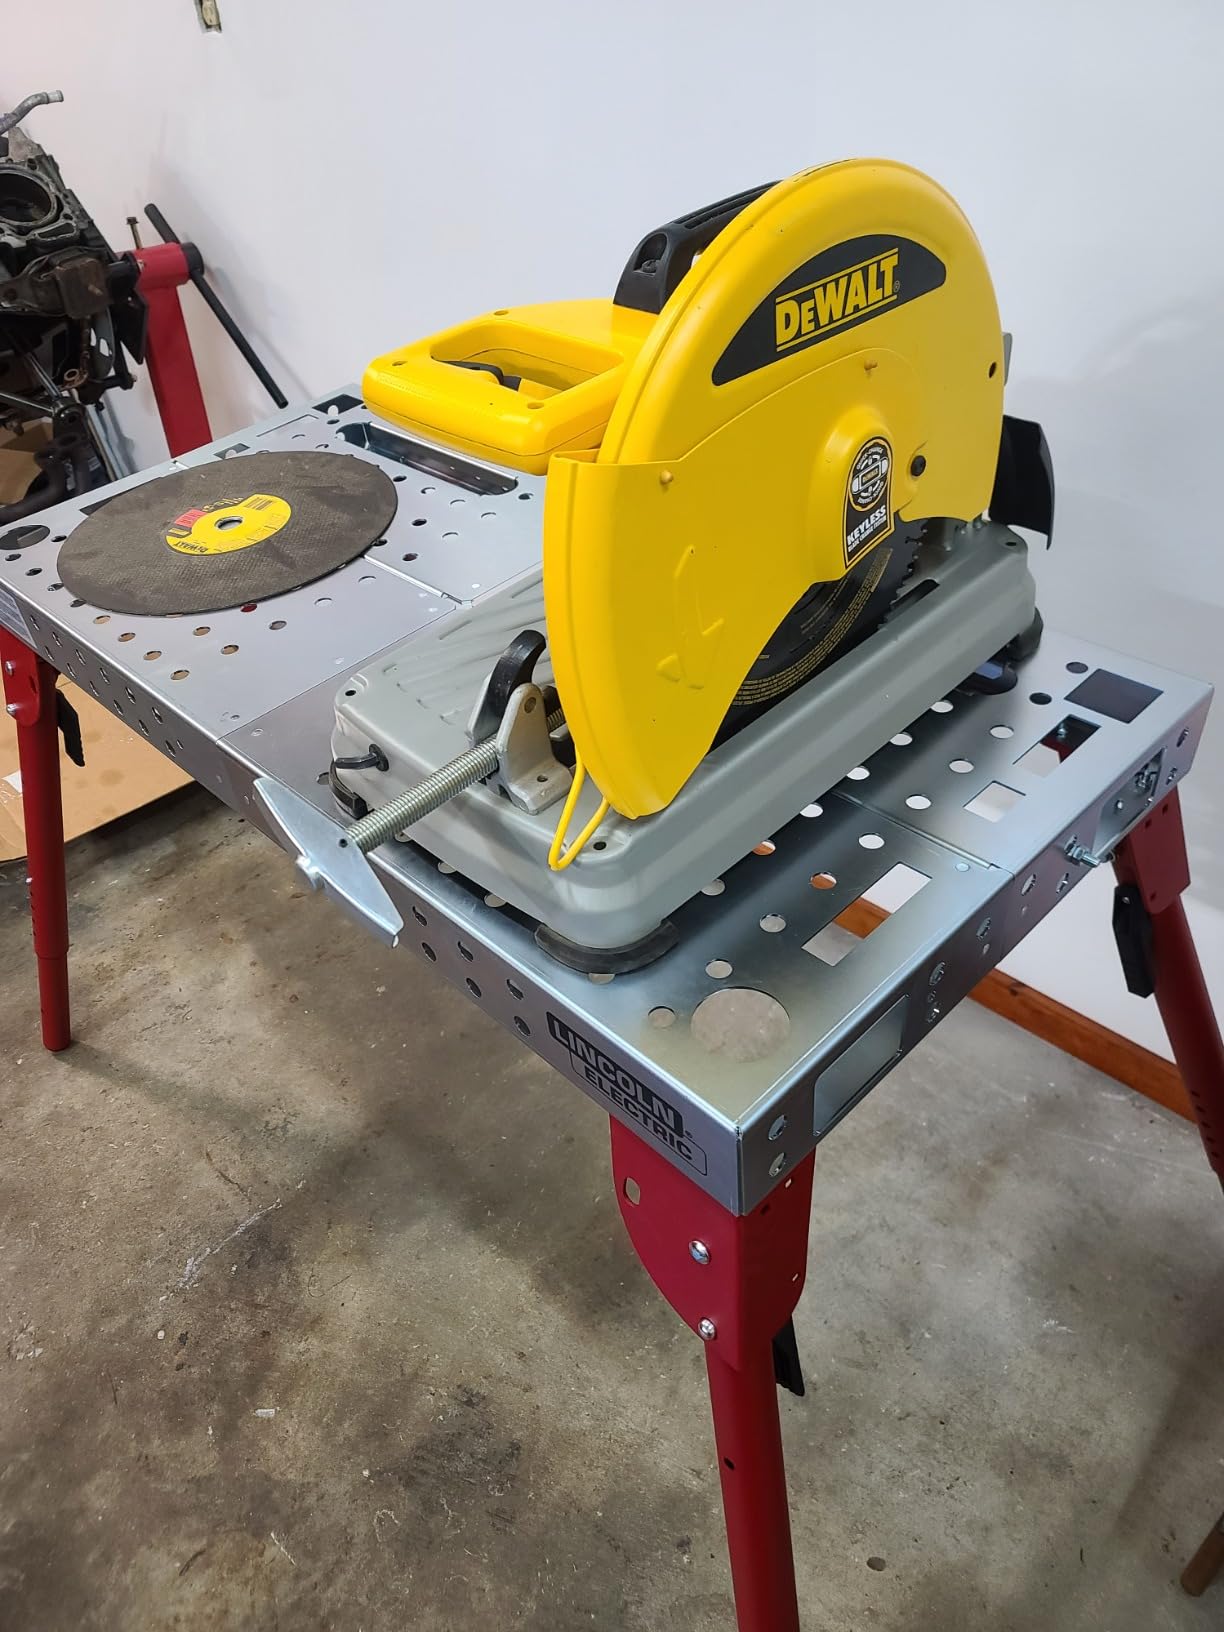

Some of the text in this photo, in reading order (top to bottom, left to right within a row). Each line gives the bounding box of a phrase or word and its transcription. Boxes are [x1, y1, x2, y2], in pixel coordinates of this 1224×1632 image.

[847, 504, 886, 546] KEYLESS
[553, 1019, 676, 1130] LINCOLN
[584, 1065, 693, 1161] ELECTRIC
